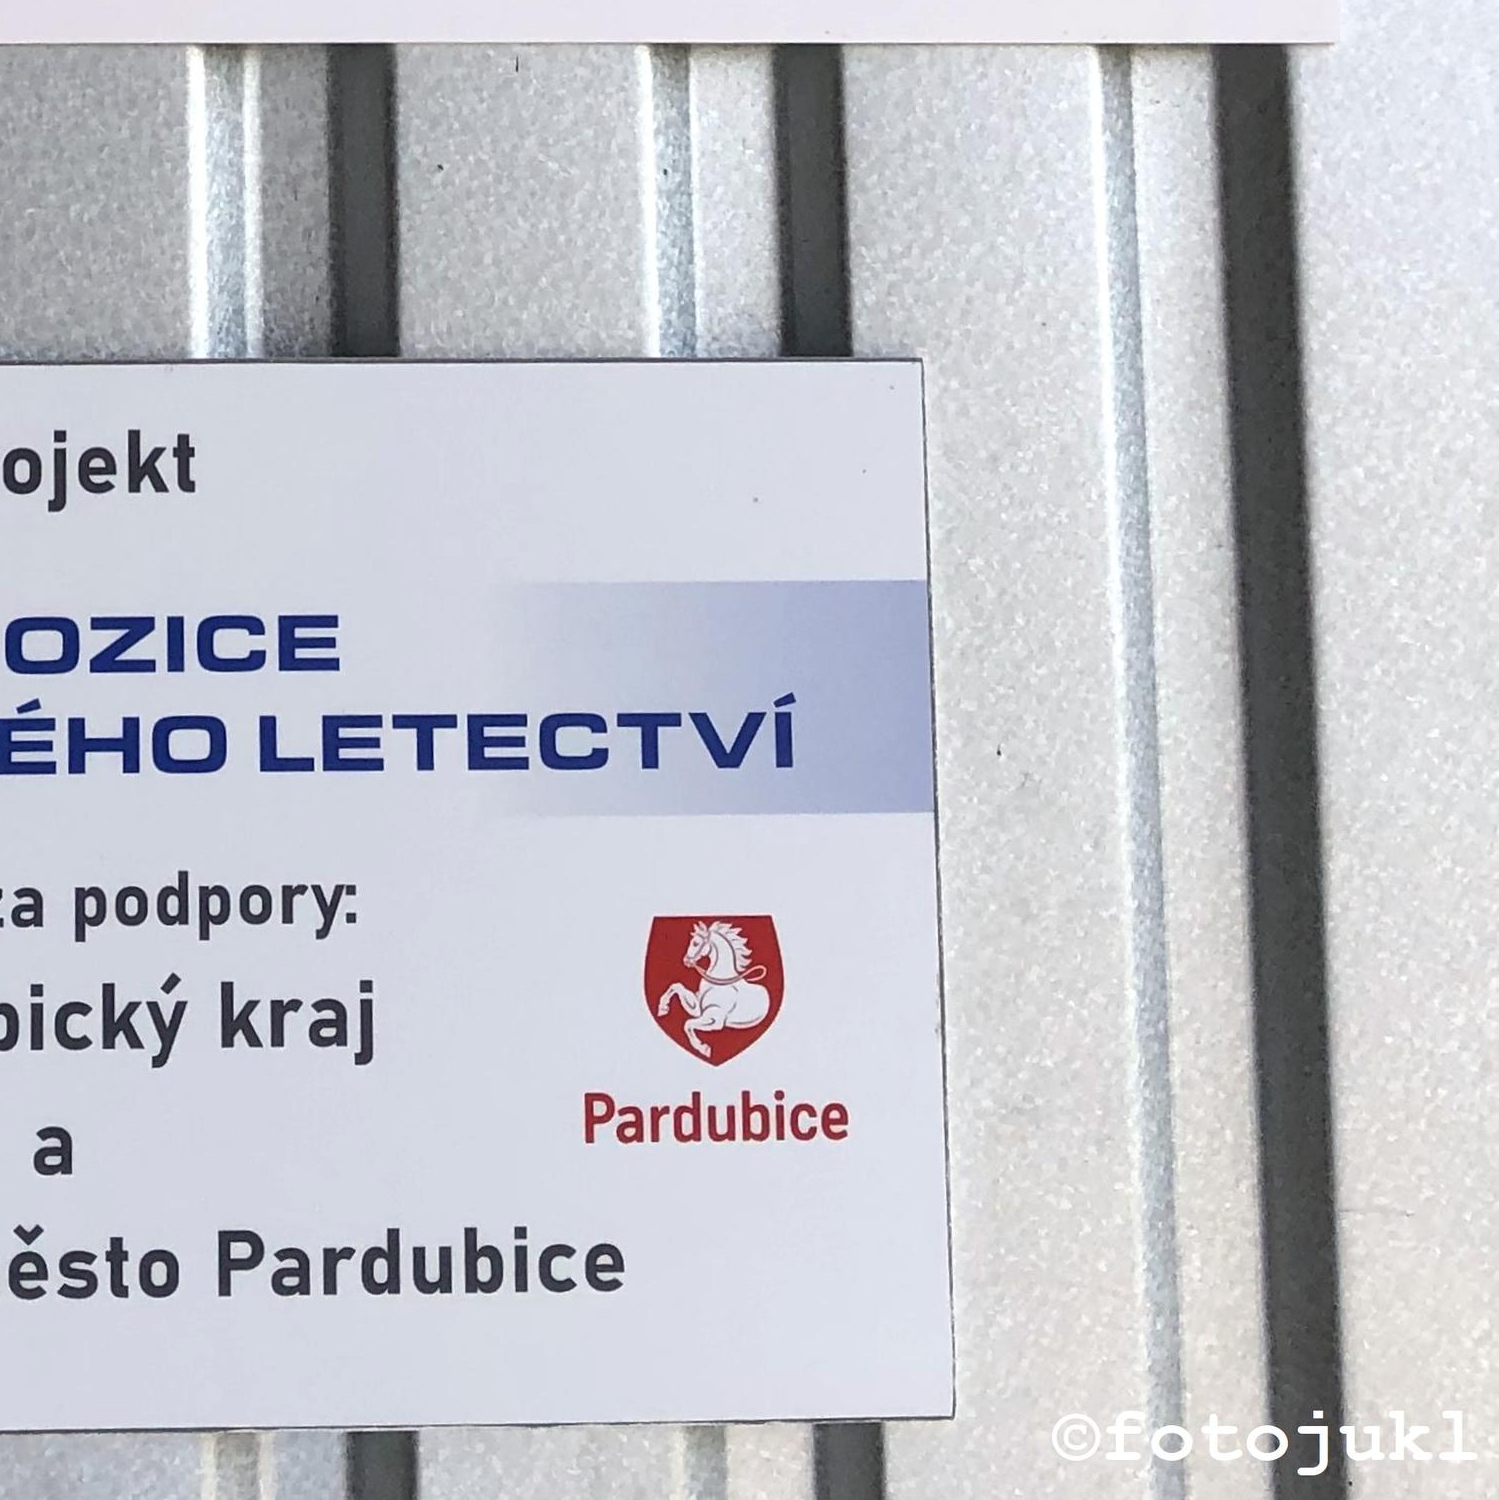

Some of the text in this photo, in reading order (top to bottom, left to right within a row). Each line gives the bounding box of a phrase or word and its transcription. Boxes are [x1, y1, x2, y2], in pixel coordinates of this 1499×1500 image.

[259, 691, 797, 773] LETECTVÍ
[74, 871, 357, 943] podpory:
[220, 979, 374, 1066] kraj
[33, 1126, 73, 1176] a
[584, 1089, 849, 1145] Pardubice
[217, 1226, 625, 1297] Pardubice
